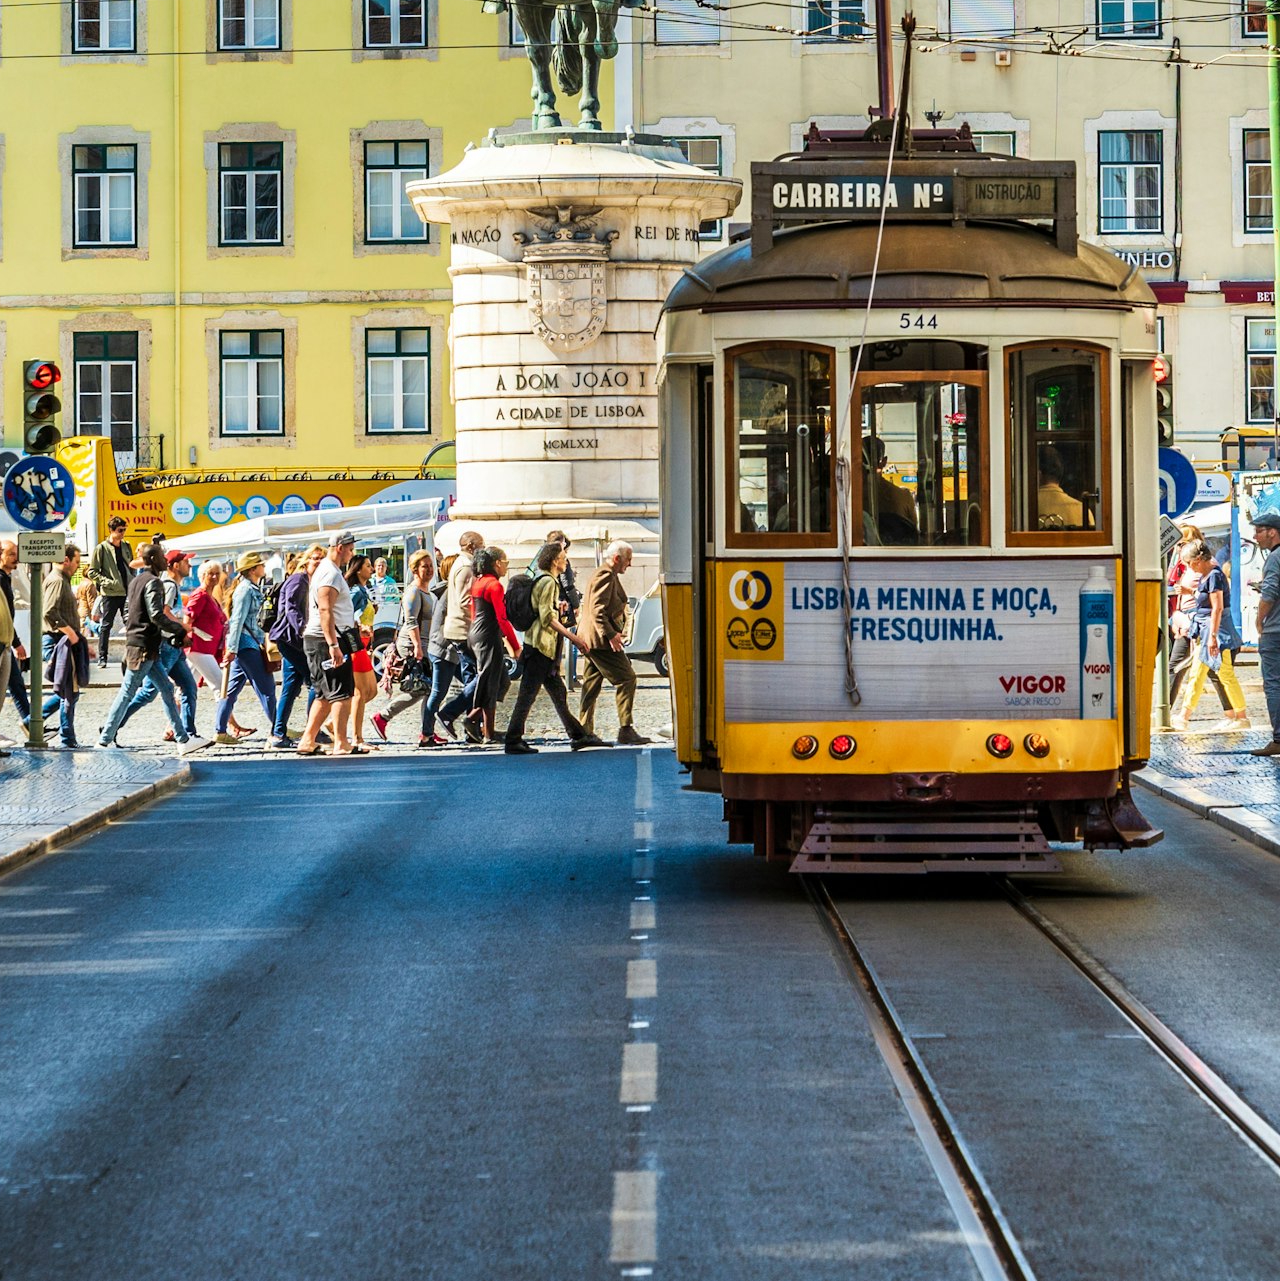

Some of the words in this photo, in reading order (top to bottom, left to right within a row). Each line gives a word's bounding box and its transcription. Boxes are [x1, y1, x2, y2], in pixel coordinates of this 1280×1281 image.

[772, 182, 898, 209] CARREIRA
[975, 182, 1041, 203] INSTRUÇÃO
[635, 226, 657, 239] REI
[666, 227, 680, 240] DE
[1115, 252, 1173, 269] INHO
[900, 313, 938, 329] 544
[496, 375, 507, 391] A
[516, 373, 559, 390] DOM
[496, 408, 505, 420] A
[510, 407, 562, 419] CIDADE
[570, 406, 588, 417] DE
[595, 405, 645, 417] LISBOA
[543, 439, 599, 450] MCMLXXI
[108, 500, 136, 511] This
[141, 499, 165, 514] city
[877, 588, 966, 611] MENINA
[973, 588, 985, 611] E
[992, 587, 1058, 618] MOÇA,
[850, 618, 1004, 643] FRESQUINHA.
[1084, 664, 1111, 674] VIGOR
[999, 675, 1066, 694] VIGOR
[1004, 696, 1031, 706] SABOR
[1033, 696, 1062, 706] FRESCO
